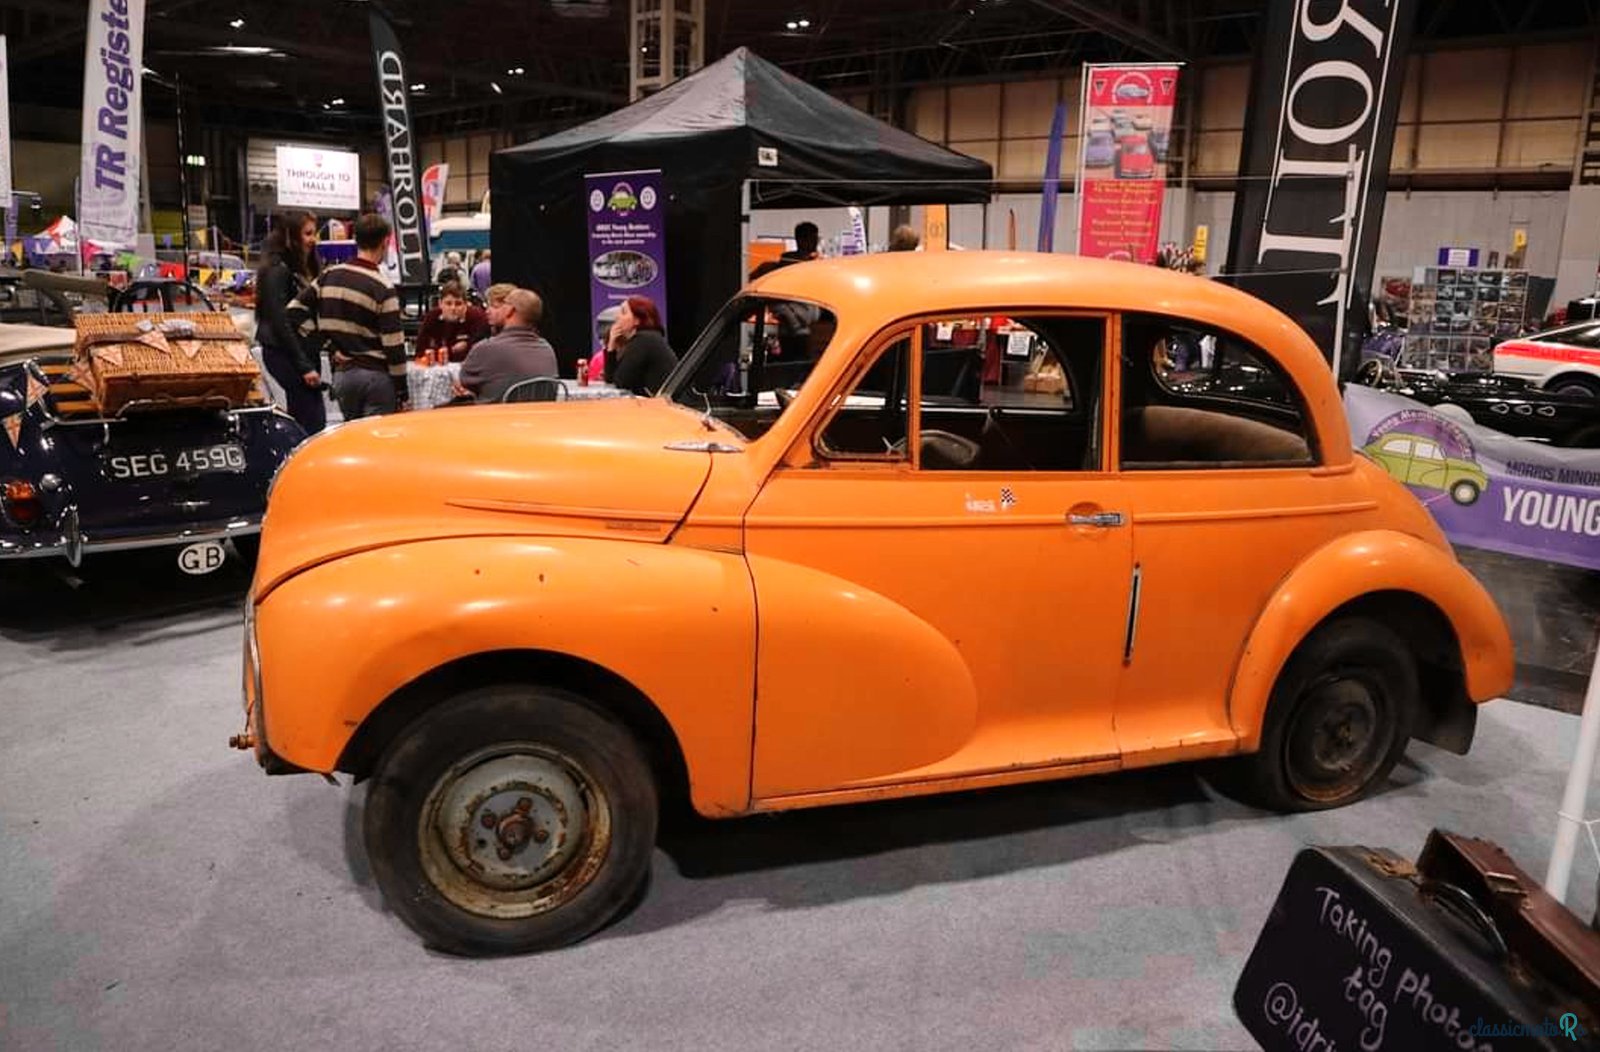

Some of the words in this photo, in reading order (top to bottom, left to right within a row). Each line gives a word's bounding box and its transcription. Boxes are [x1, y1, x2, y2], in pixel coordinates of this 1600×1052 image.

[95, 143, 126, 191] TR
[286, 169, 335, 181] THROUGH
[338, 173, 351, 182] TO
[302, 181, 327, 192] HALL
[111, 454, 168, 478] SEG
[175, 447, 243, 472] 459G
[1505, 460, 1555, 482] MORRIS
[1557, 467, 1600, 486] MINOR
[1503, 486, 1600, 536] YOUNG
[181, 546, 221, 570] GB
[1315, 886, 1392, 989] Taking
[1343, 967, 1389, 1051] tag
